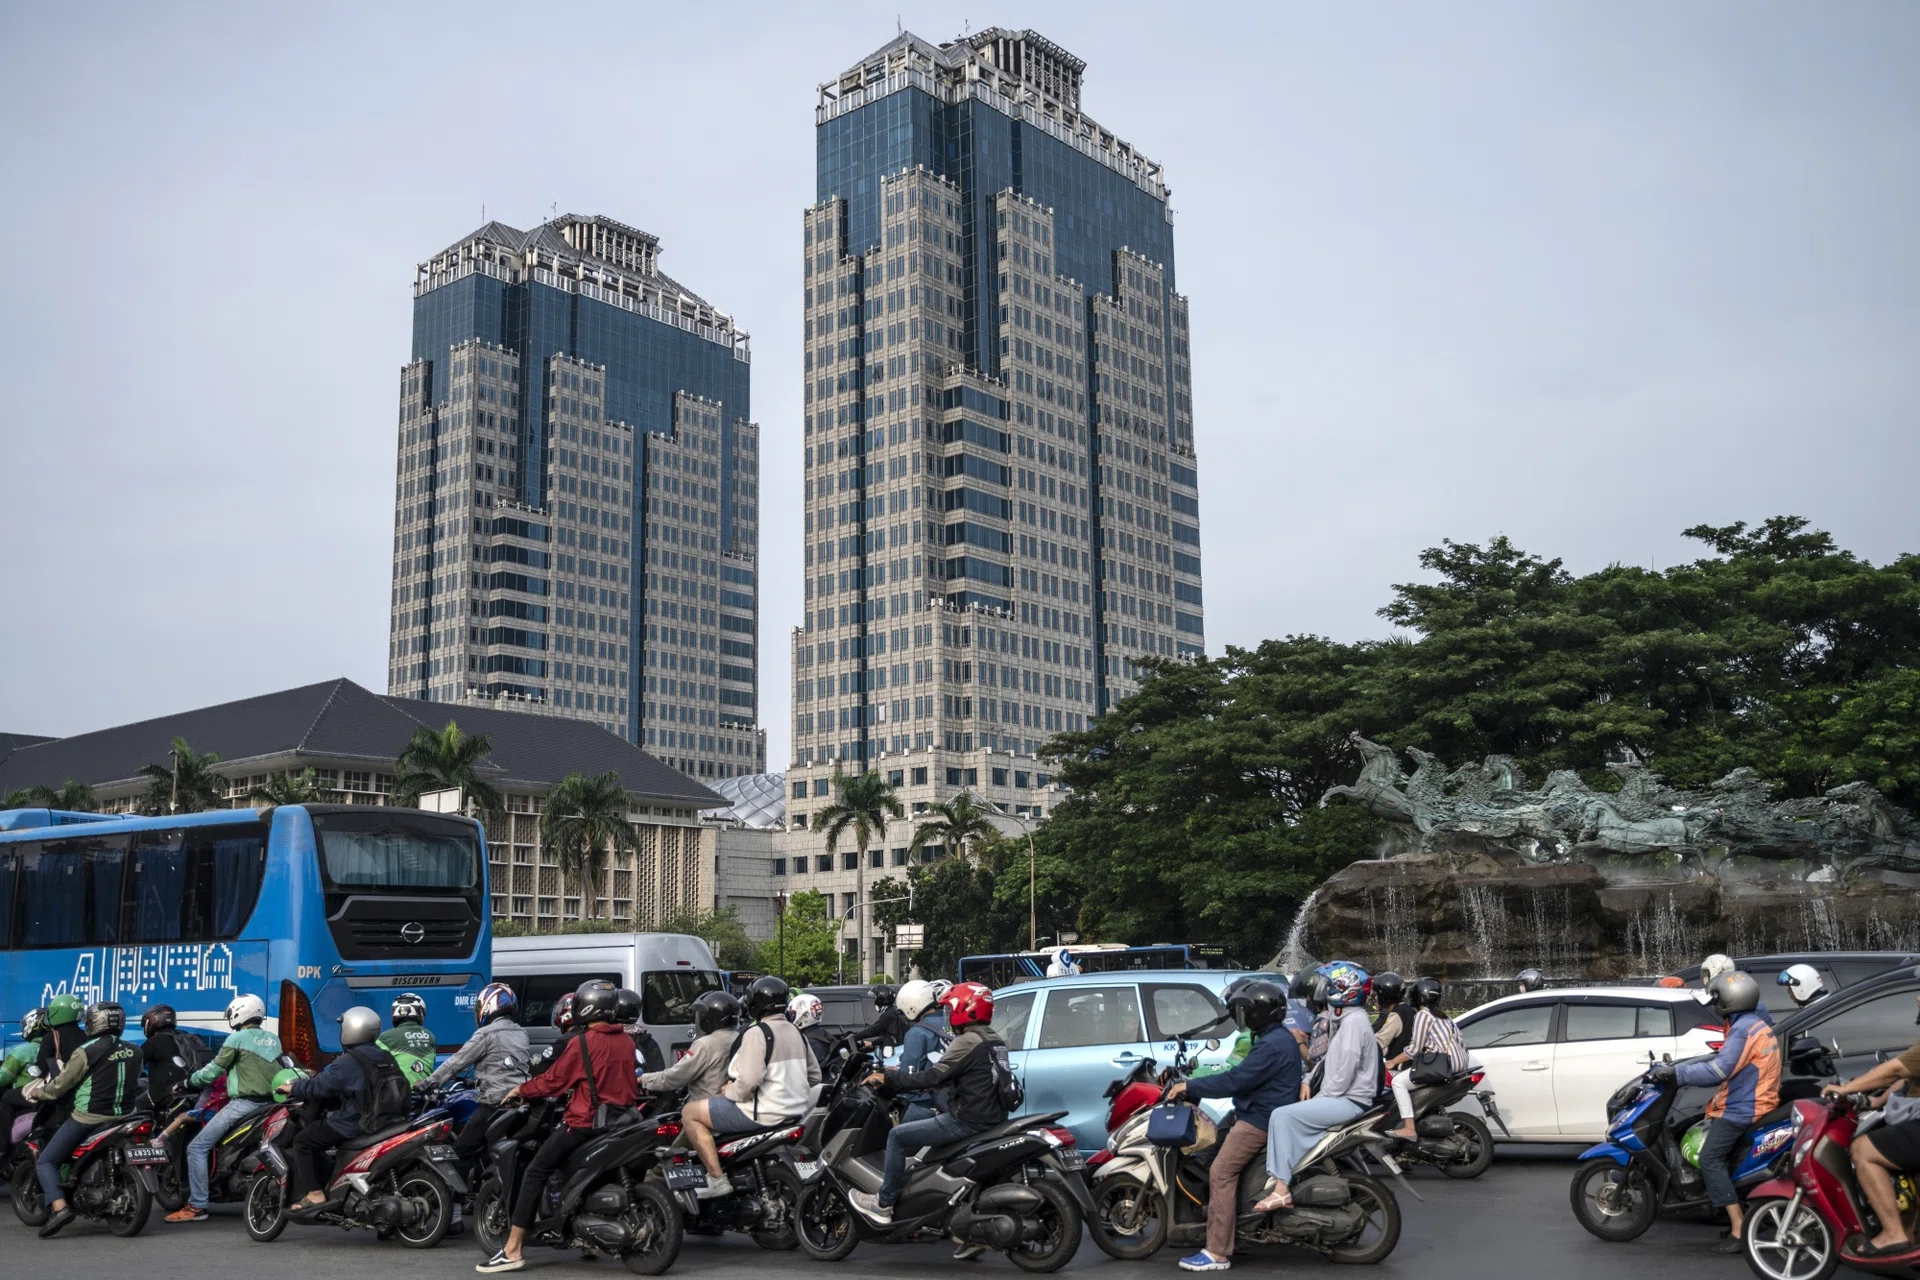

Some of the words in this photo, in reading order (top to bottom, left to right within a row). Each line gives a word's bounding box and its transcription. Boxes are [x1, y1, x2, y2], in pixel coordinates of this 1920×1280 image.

[298, 966, 321, 978] DPK
[392, 976, 441, 985] DISCOVERY
[455, 996, 469, 1005] DMR
[404, 1030, 429, 1039] Grab
[254, 1036, 277, 1047] Grab
[1164, 1043, 1176, 1051] KK
[1184, 1042, 1198, 1050] 219
[669, 1170, 682, 1179] AA
